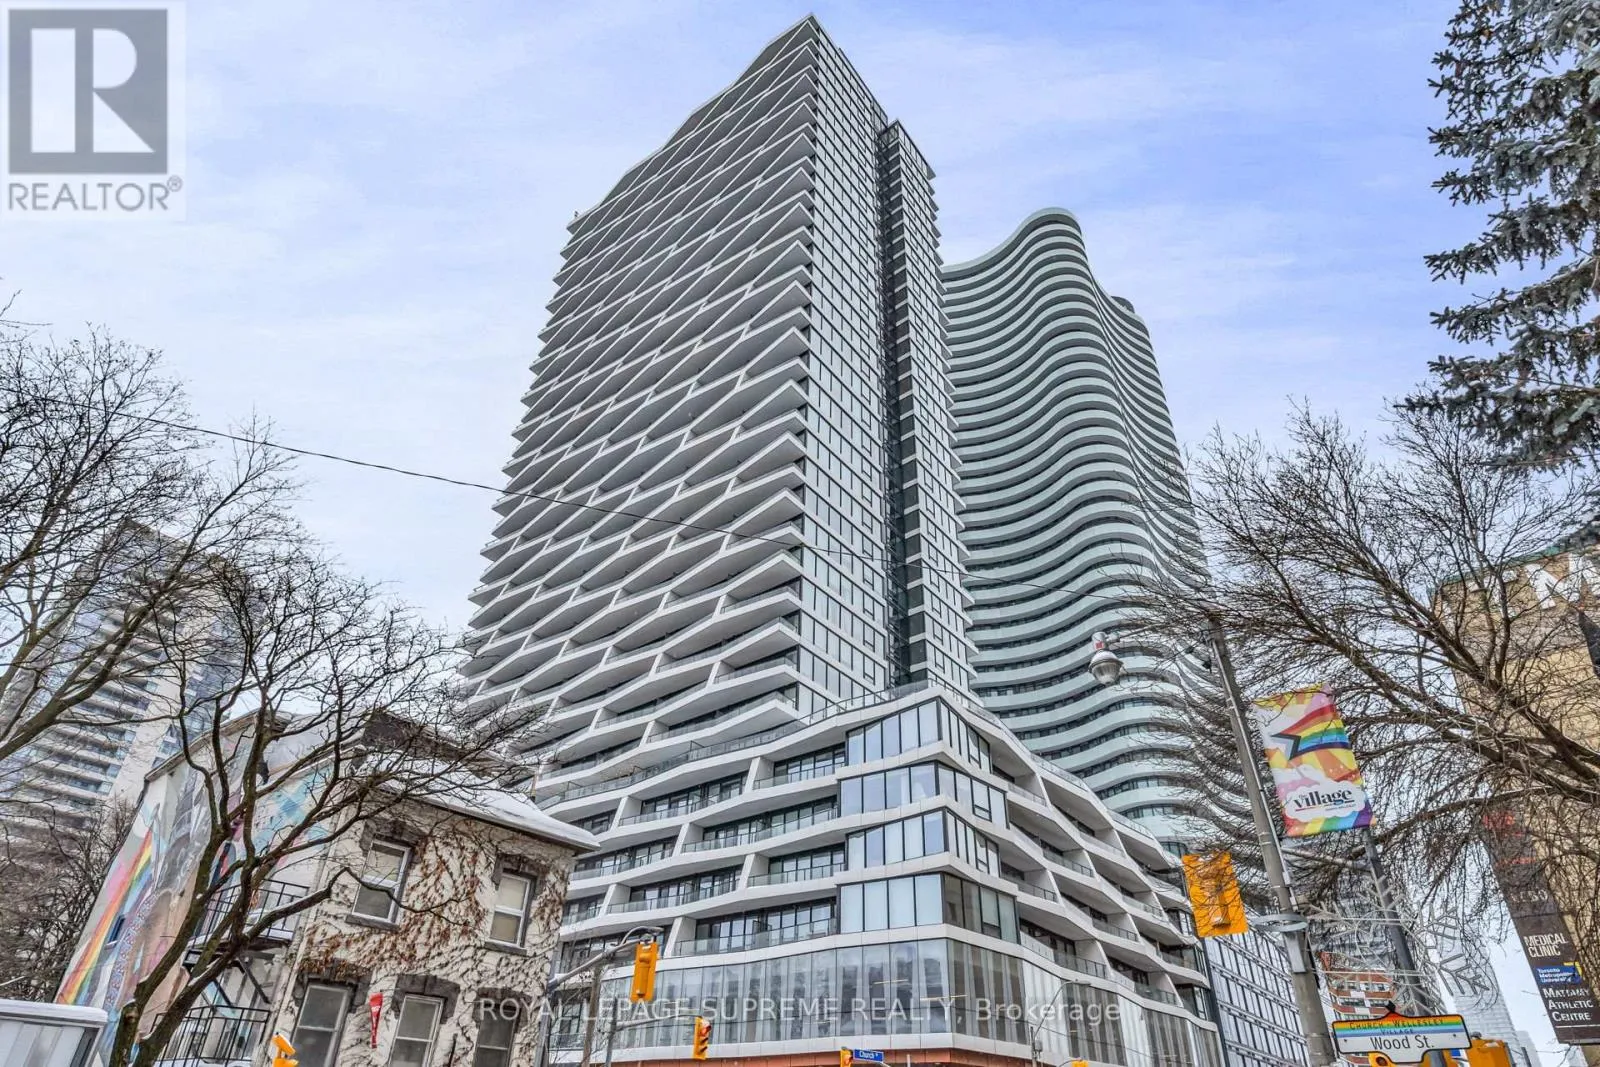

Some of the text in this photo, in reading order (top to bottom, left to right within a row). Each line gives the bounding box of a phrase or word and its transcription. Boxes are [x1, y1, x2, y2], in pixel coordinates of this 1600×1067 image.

[1524, 933, 1568, 946] MEDICAL
[1528, 944, 1561, 958] CLINIC
[1548, 999, 1594, 1010] ATHLETIC
[1552, 1011, 1592, 1022] CENTRE
[1350, 1018, 1444, 1030] CHURCH WELLESLEY
[1381, 1028, 1415, 1036] VILLAGE
[1370, 1034, 1435, 1050] Wood St.
